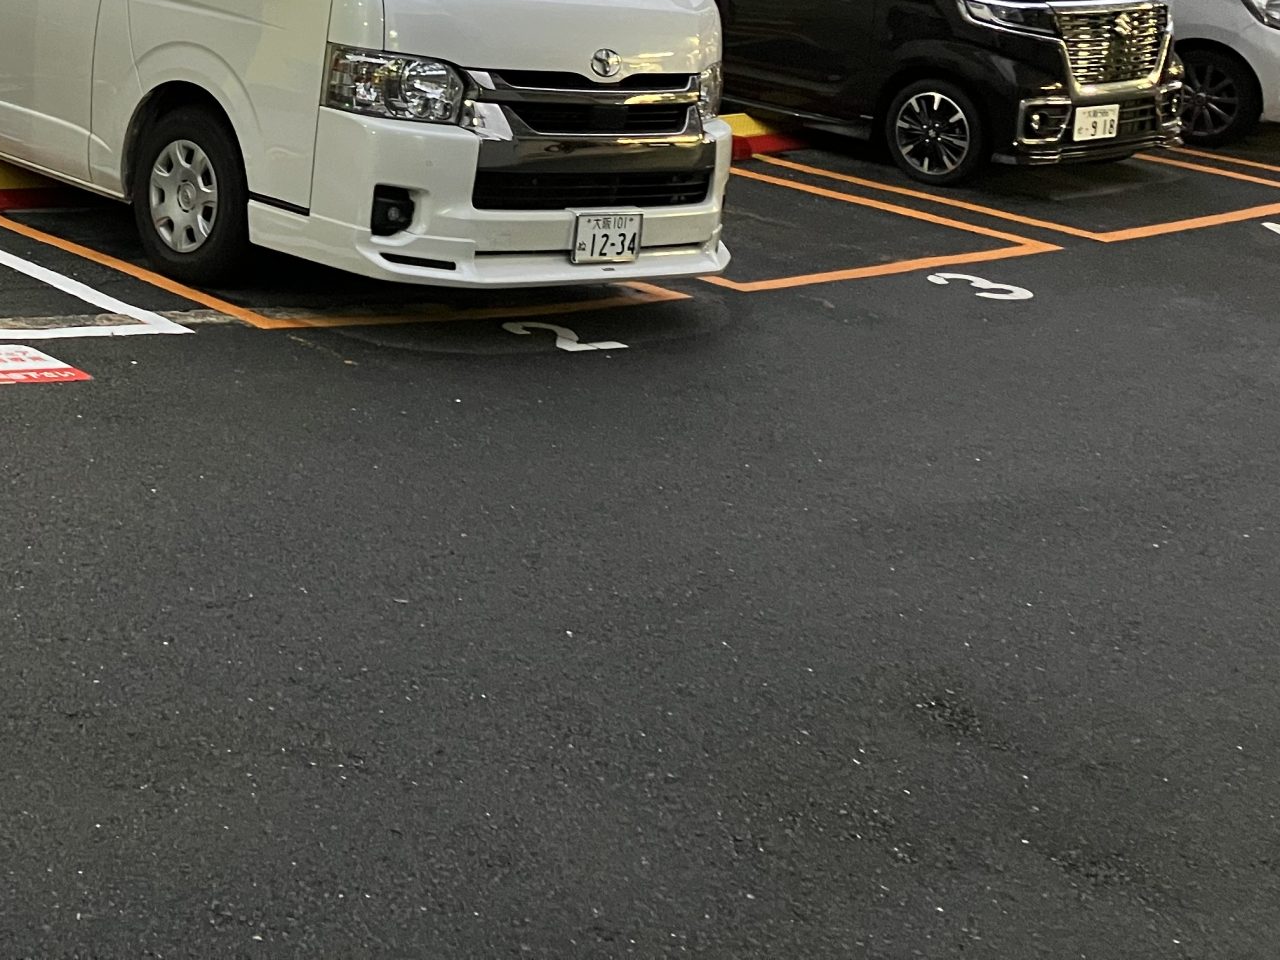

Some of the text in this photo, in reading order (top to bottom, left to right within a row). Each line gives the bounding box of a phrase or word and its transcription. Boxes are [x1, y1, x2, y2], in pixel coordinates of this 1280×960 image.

[591, 232, 637, 257] 12-34
[926, 271, 1036, 301] 3
[502, 321, 630, 353] 2
